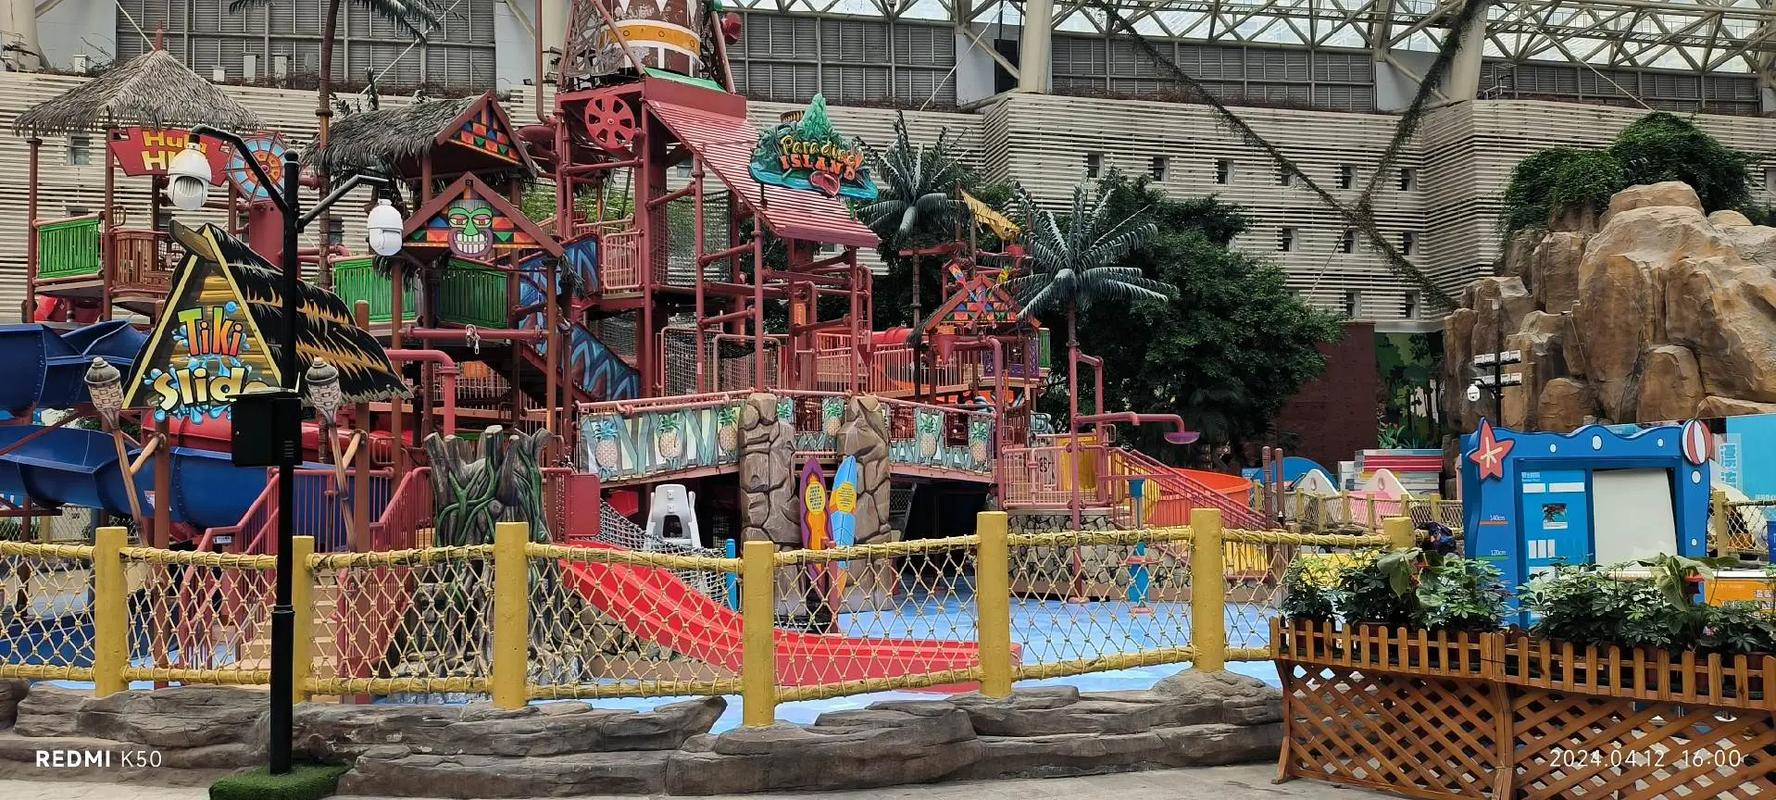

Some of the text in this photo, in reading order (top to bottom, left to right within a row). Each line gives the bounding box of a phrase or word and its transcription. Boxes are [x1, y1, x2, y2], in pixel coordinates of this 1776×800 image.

[780, 134, 857, 169] Paradise
[780, 153, 856, 181] ISLAND
[177, 306, 244, 356] Tiki
